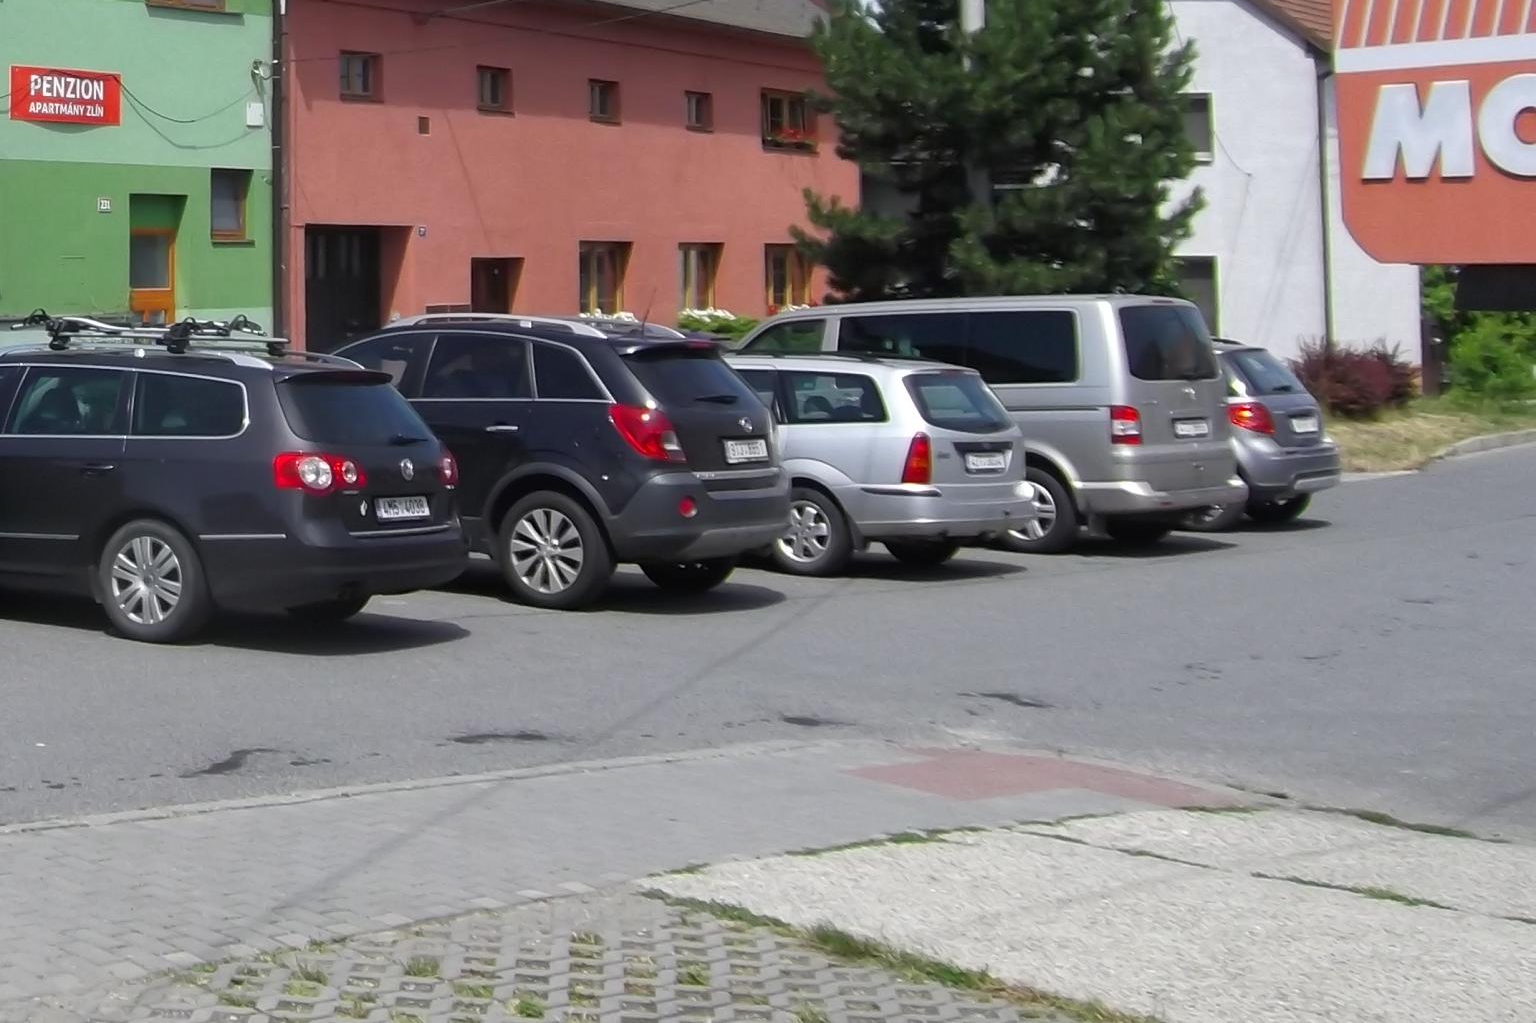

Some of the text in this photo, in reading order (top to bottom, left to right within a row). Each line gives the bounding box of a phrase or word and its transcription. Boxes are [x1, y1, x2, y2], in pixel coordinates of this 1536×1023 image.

[30, 74, 104, 100] PENZION
[28, 101, 104, 117] APARTMÁNY ZLÍN
